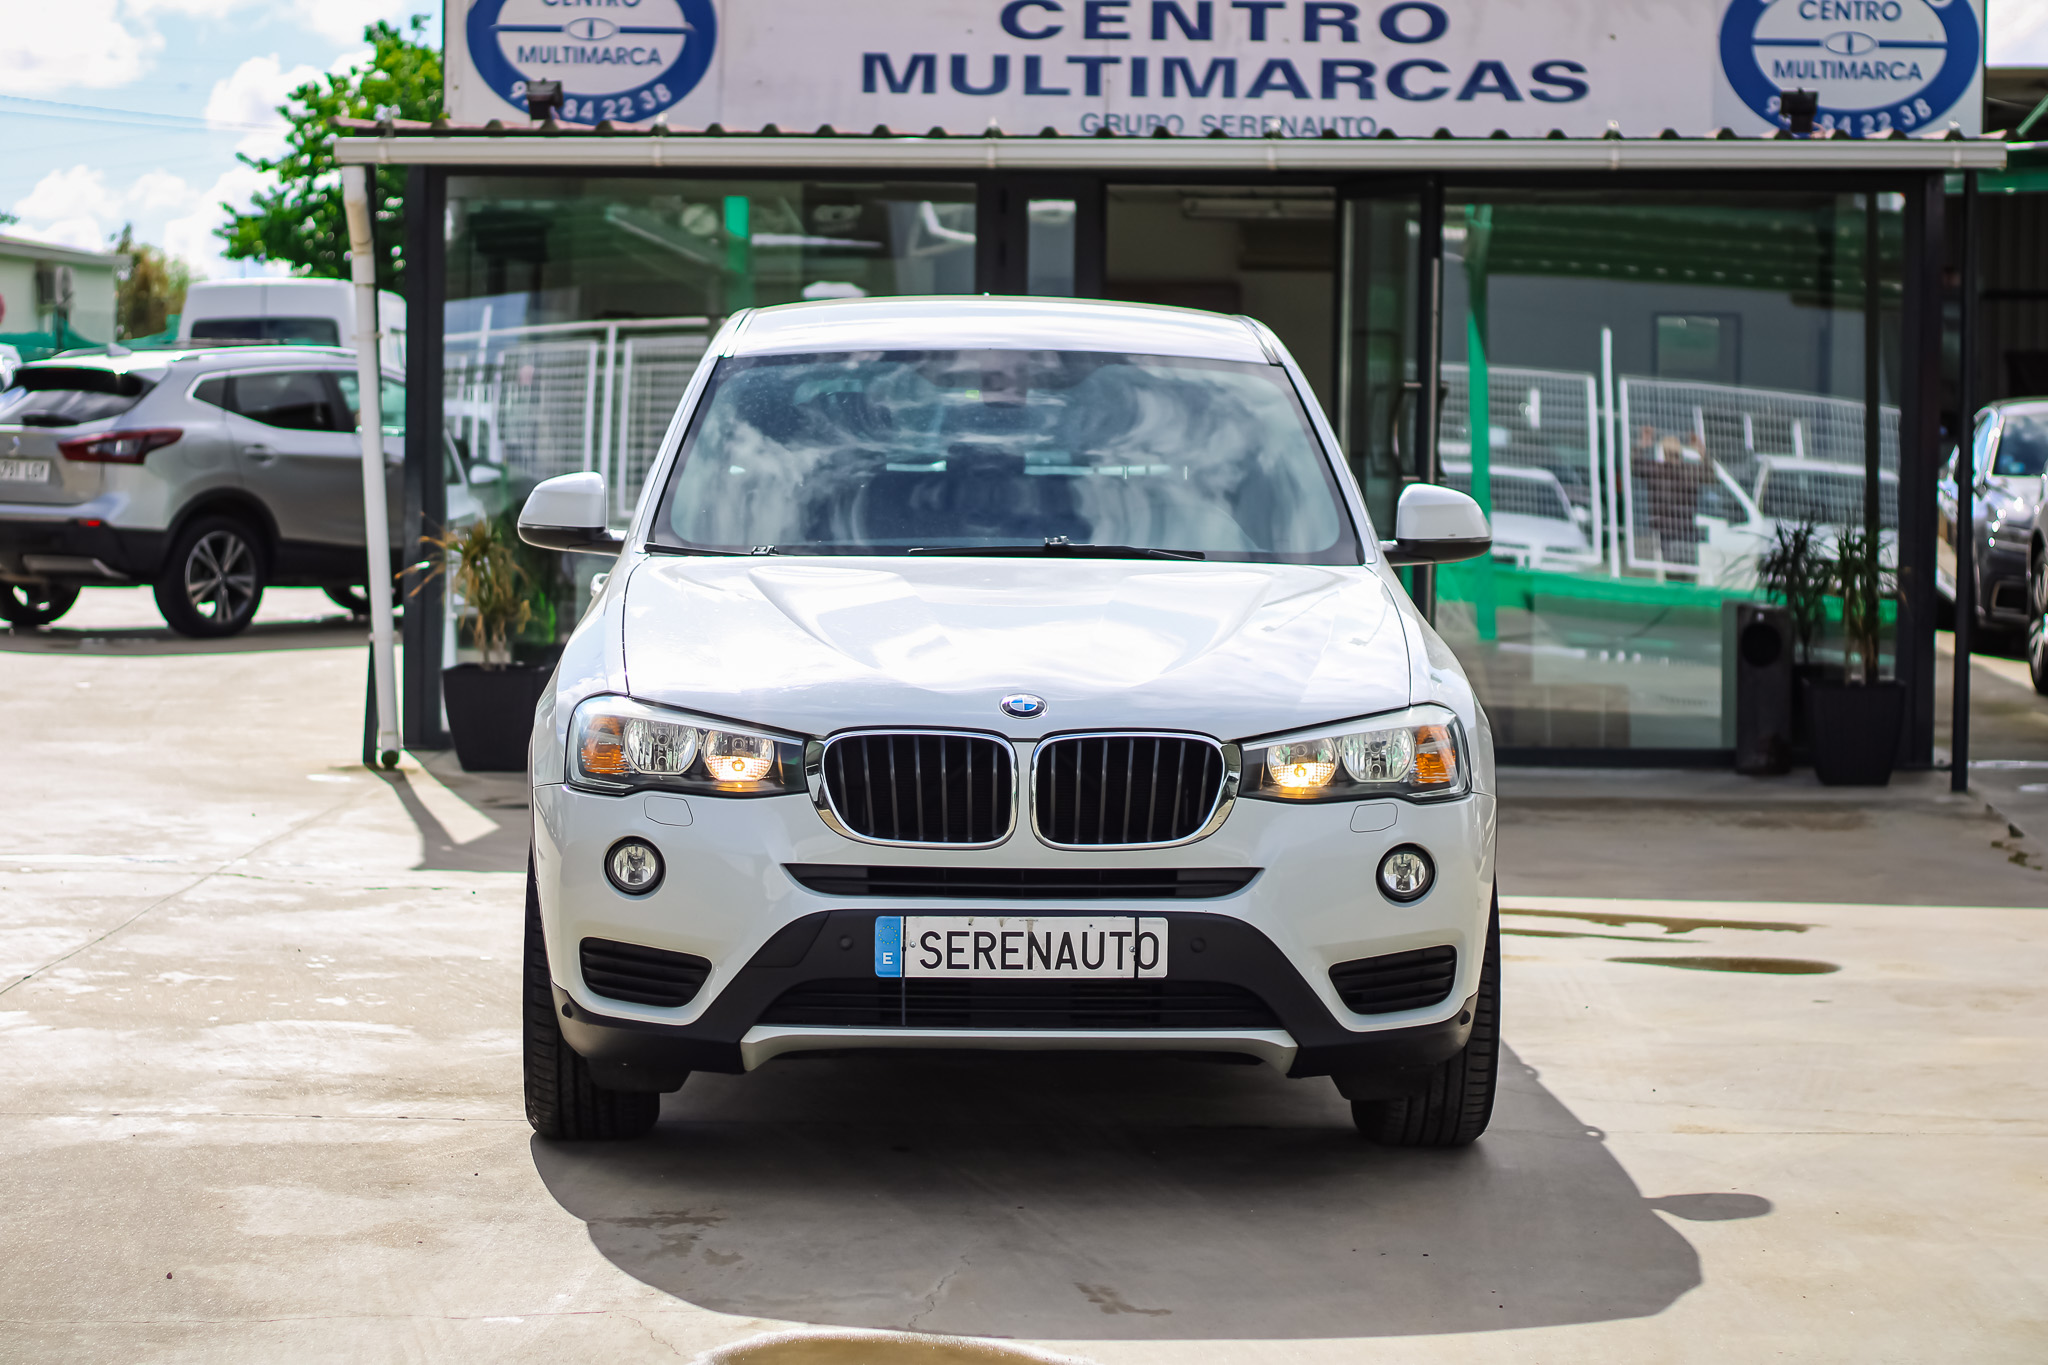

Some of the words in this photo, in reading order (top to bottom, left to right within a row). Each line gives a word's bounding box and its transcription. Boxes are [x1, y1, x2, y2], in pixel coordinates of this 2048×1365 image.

[1000, 0, 1449, 44] CENTRO
[1799, 0, 1902, 22] CENTRO
[517, 46, 662, 66] MULTIMARCA
[861, 52, 1591, 103] MULTIMARCAS
[1773, 59, 1923, 81] MULTIMARCA
[601, 96, 635, 120] 22
[640, 83, 672, 110] 38
[1899, 98, 1932, 127] 38
[1080, 113, 1185, 136] GRUPO
[882, 952, 894, 965] E
[919, 930, 1160, 971] SERENAUTO
